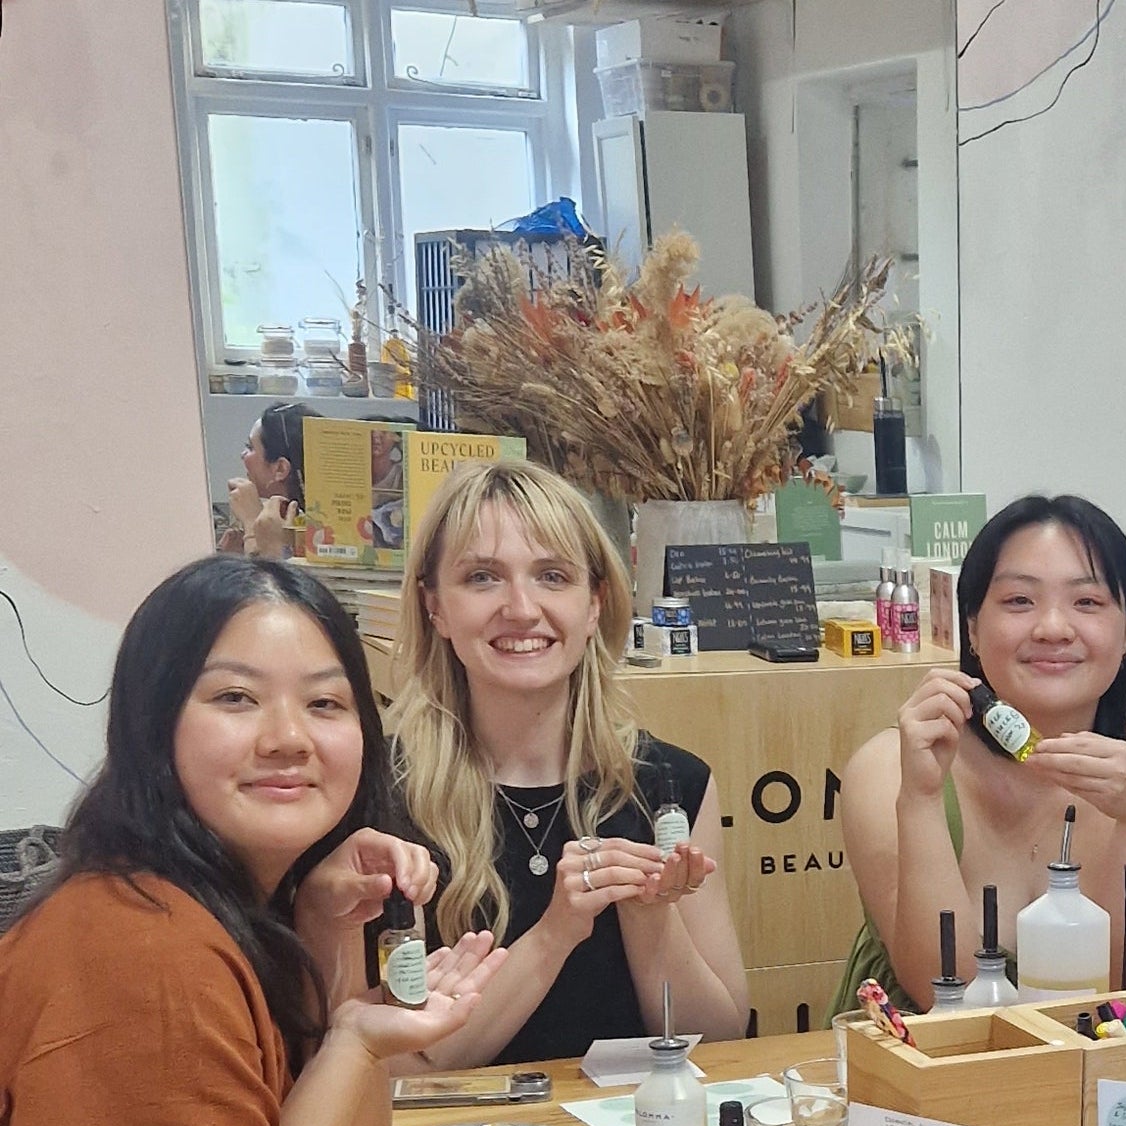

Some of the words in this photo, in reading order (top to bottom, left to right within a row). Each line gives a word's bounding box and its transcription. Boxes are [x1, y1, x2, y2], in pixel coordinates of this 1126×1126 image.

[420, 441, 495, 458] UPCYCLED
[934, 521, 968, 540] CALM
[760, 850, 844, 875] BEAU
